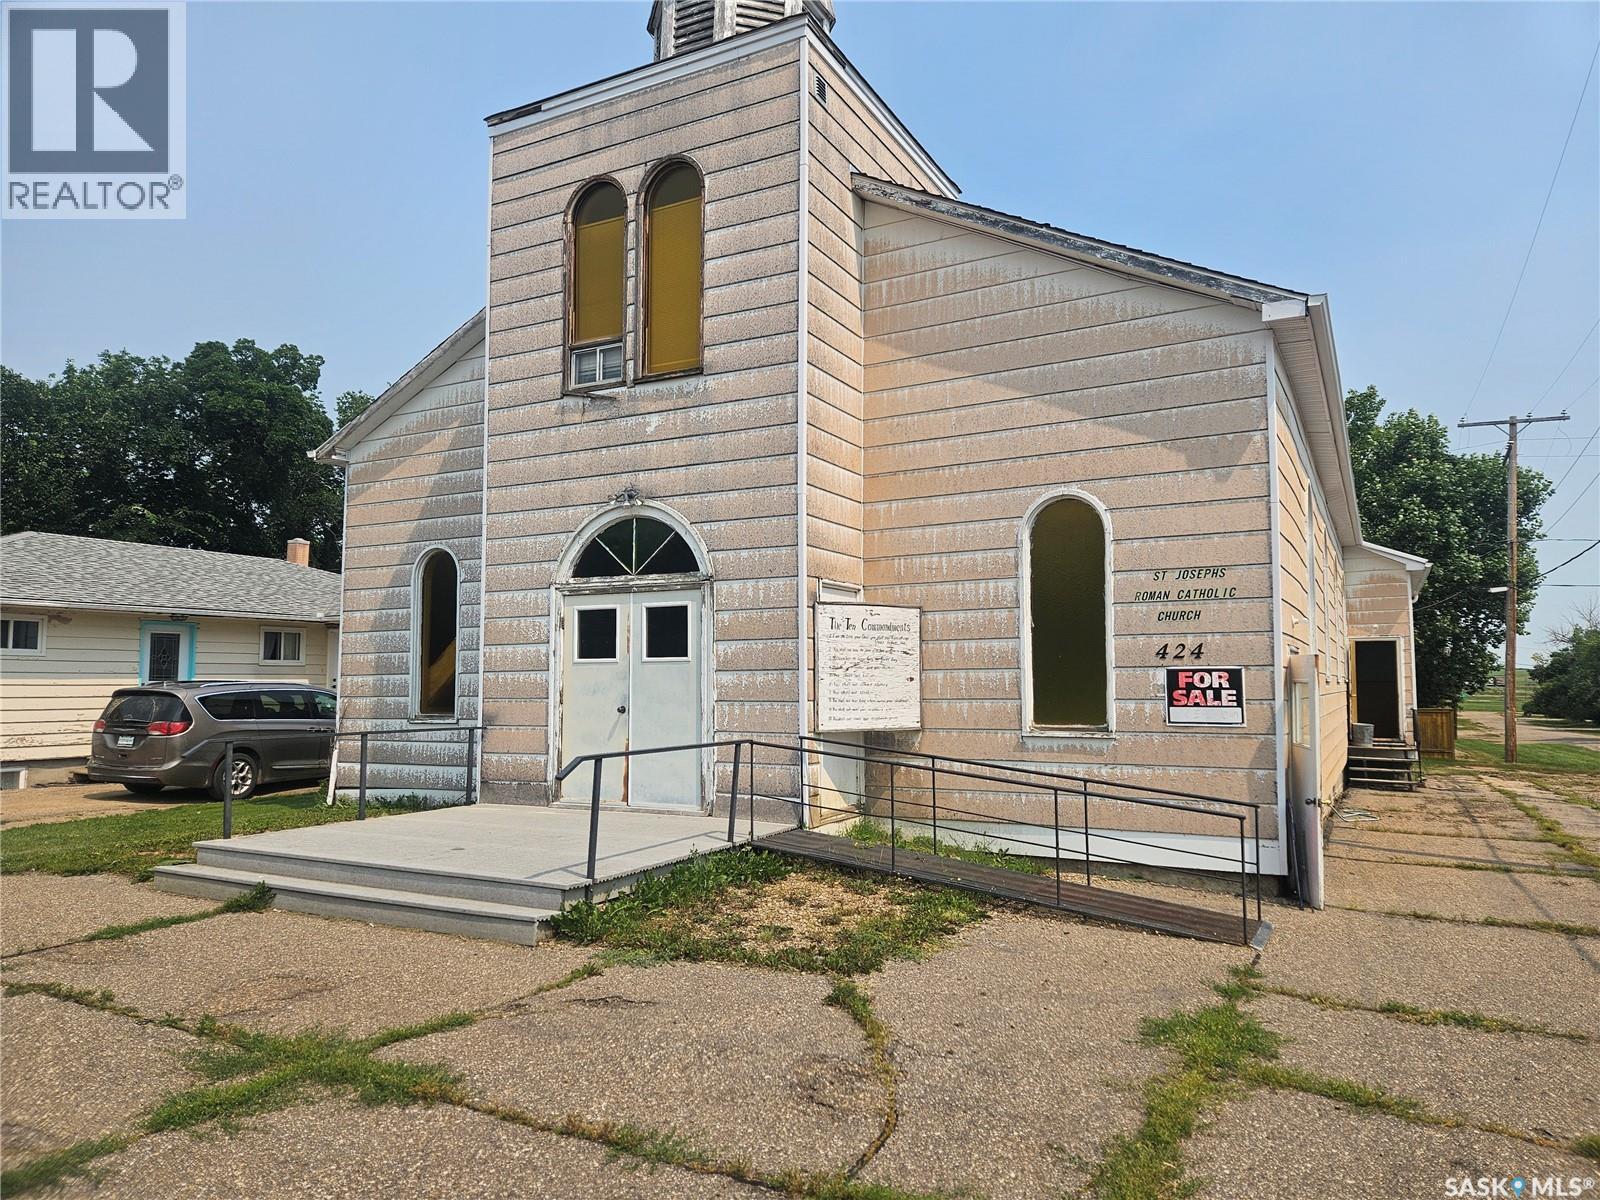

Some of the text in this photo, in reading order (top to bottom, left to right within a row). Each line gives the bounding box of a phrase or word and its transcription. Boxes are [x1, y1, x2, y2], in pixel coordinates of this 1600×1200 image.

[1153, 567, 1227, 581] ST JOSEPHS
[1134, 586, 1237, 602] ROMAN CATHOLIC
[1157, 609, 1202, 621] CHURCH
[844, 616, 857, 631] Ten
[1155, 642, 1204, 660] 424
[1178, 671, 1230, 688] FOR
[1172, 689, 1238, 706] SALE
